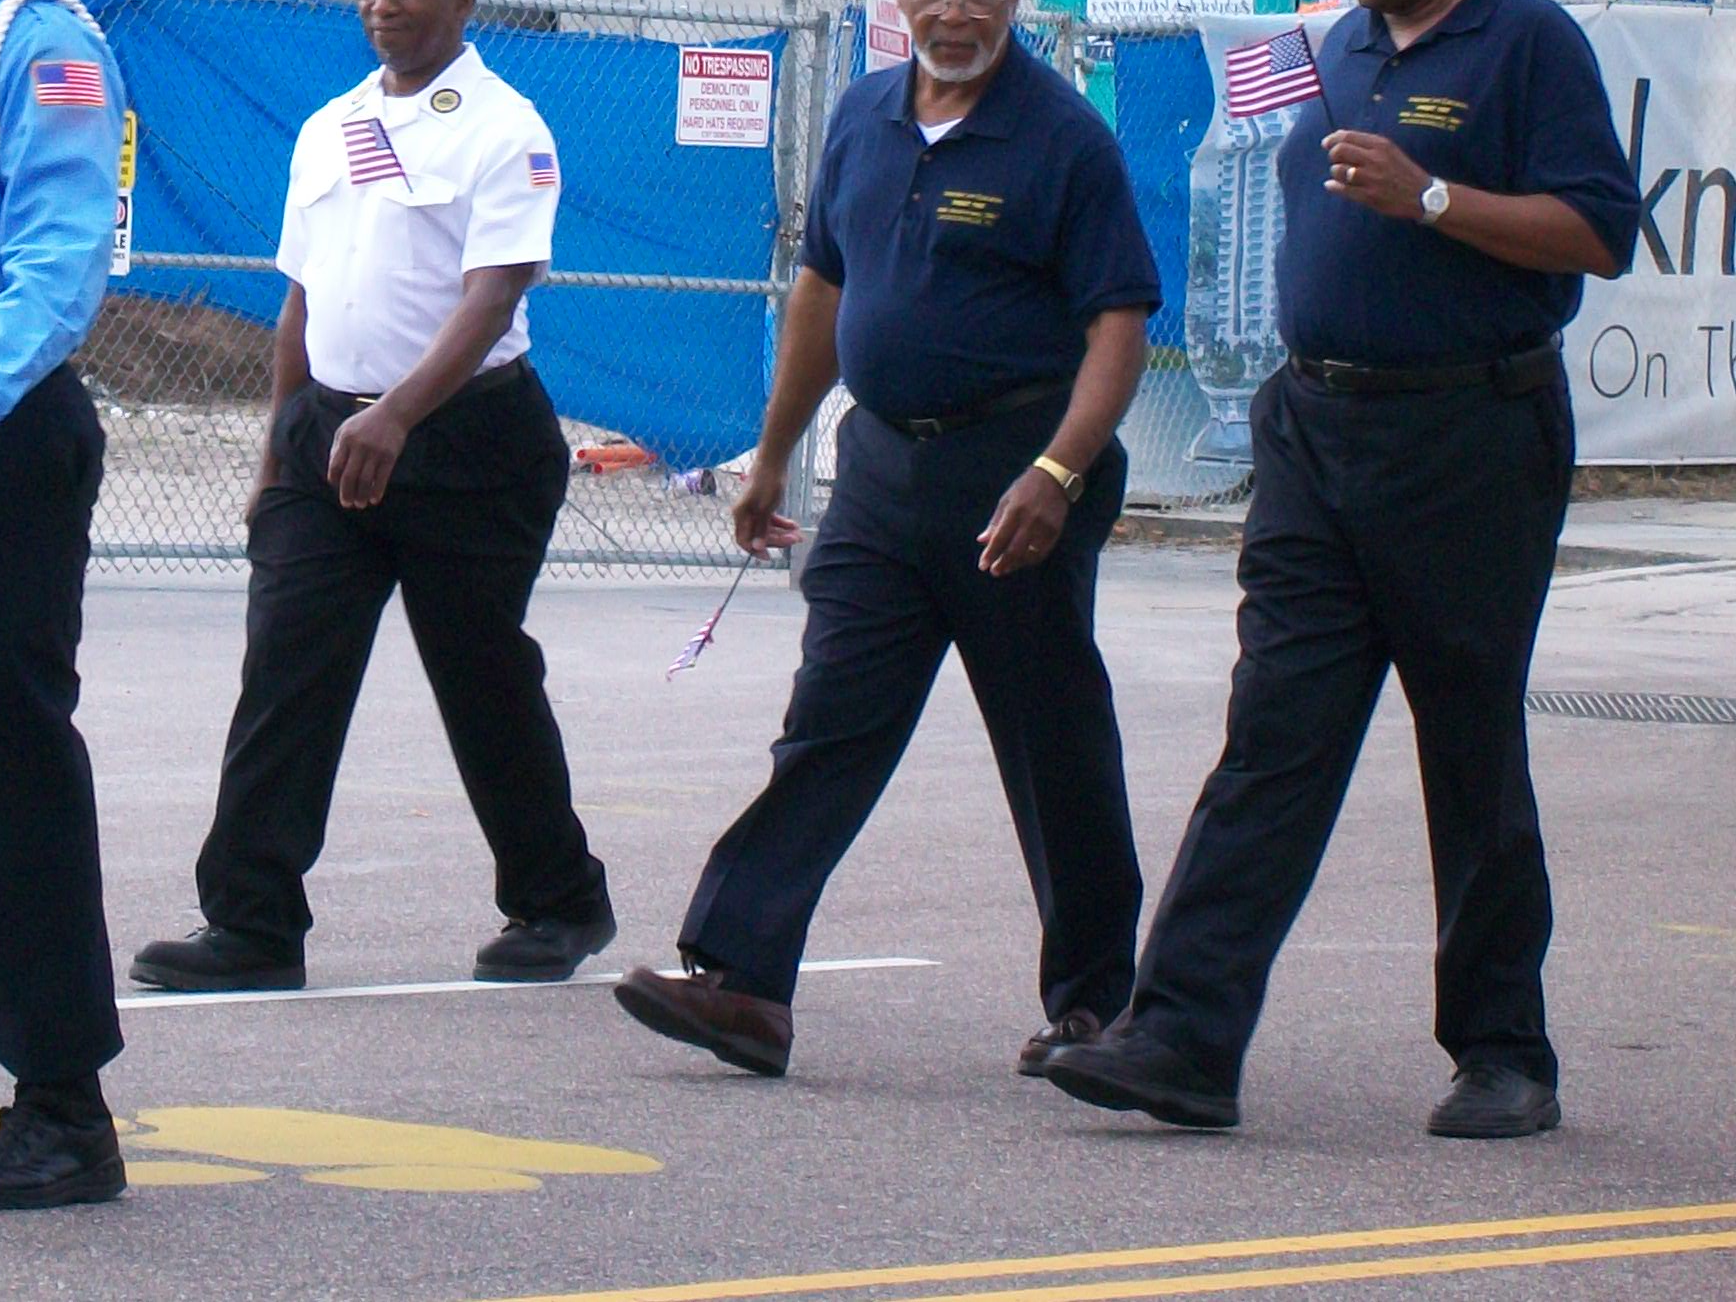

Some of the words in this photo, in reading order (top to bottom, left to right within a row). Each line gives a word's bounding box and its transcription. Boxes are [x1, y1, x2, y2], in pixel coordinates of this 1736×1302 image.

[684, 54, 700, 75] NO
[701, 56, 768, 77] TRESPASSING
[701, 82, 750, 96] DEMOLITION
[689, 98, 737, 111] PERSONNEL
[739, 100, 760, 112] ONLY
[682, 116, 704, 128] HARD
[706, 117, 725, 129] HATS
[1590, 324, 1668, 399] On
